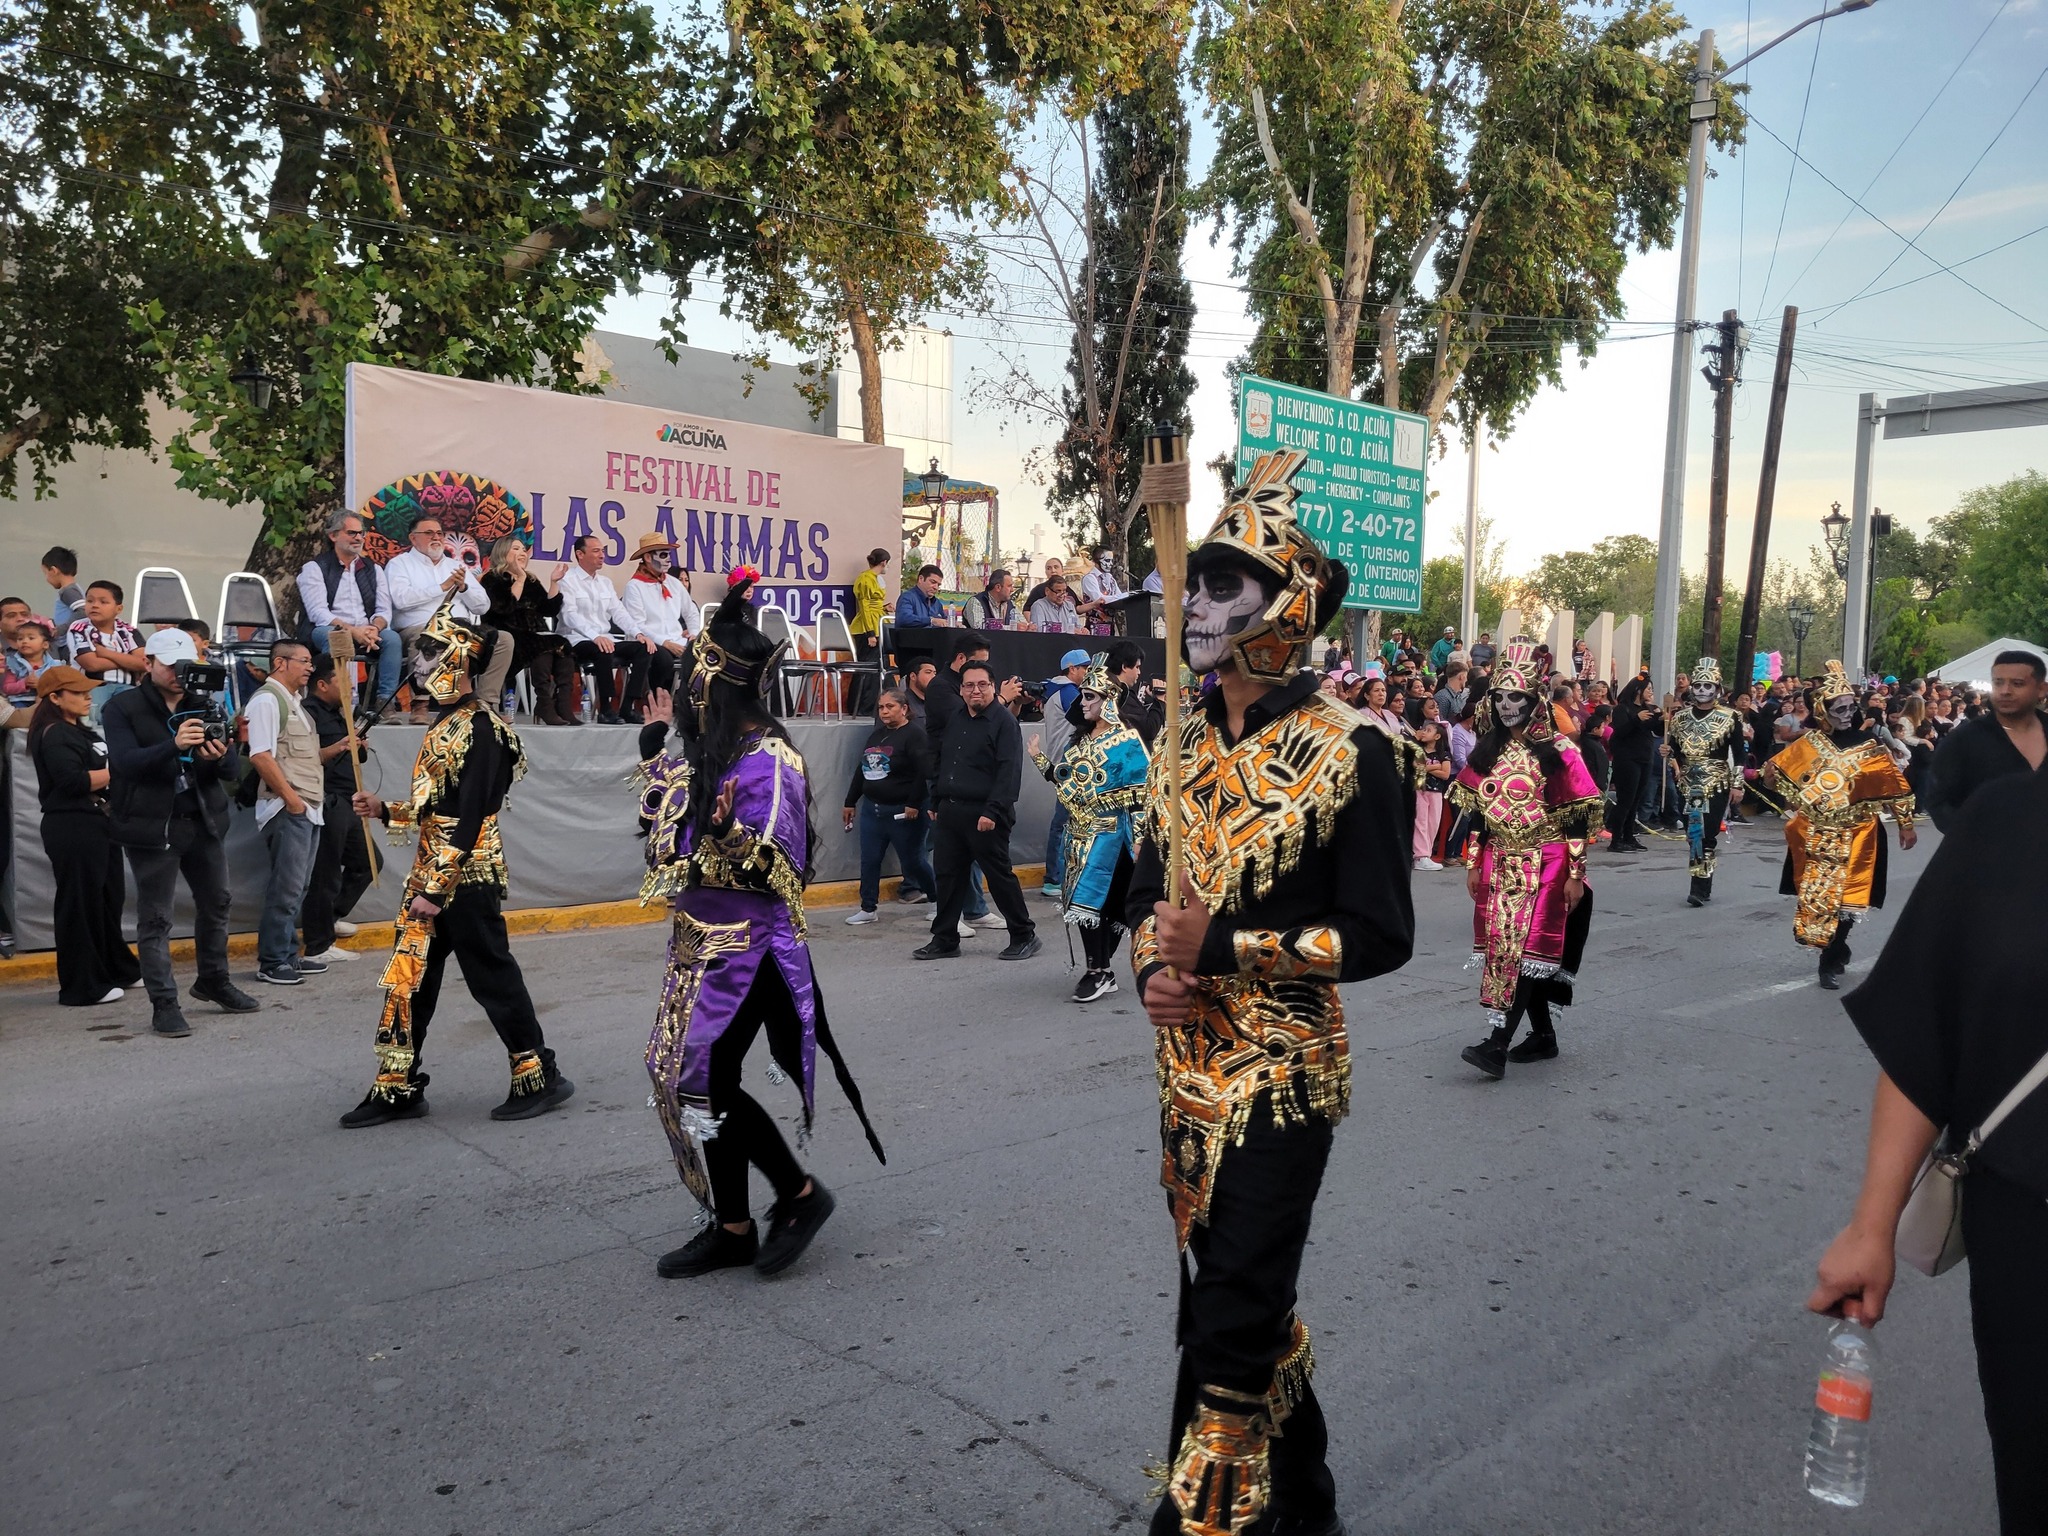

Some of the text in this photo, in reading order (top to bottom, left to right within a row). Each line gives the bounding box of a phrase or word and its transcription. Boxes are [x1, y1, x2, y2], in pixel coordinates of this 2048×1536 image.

[1277, 396, 1390, 439] BIENVENIDOS A CD. ACUÑA
[669, 428, 727, 450] ACUÑA
[1276, 422, 1389, 463] WELCOME TO CD. ACUÑA
[606, 451, 781, 508] FESTIVAL DE
[1325, 482, 1364, 501] EMERGENCY
[1332, 463, 1357, 481] AUXILIO
[1360, 468, 1390, 487] TURISTICO
[1396, 475, 1420, 492] QUEJAS
[530, 492, 830, 582] LAS ÁNIMAS
[1341, 509, 1416, 542] 2-40-72
[1338, 542, 1354, 557] DE
[1361, 545, 1410, 563] TURISMO
[1364, 562, 1419, 586] (INTERIOR)
[762, 588, 845, 622] 2025
[1359, 583, 1370, 598] DE
[1373, 584, 1417, 602] COAHUILA
